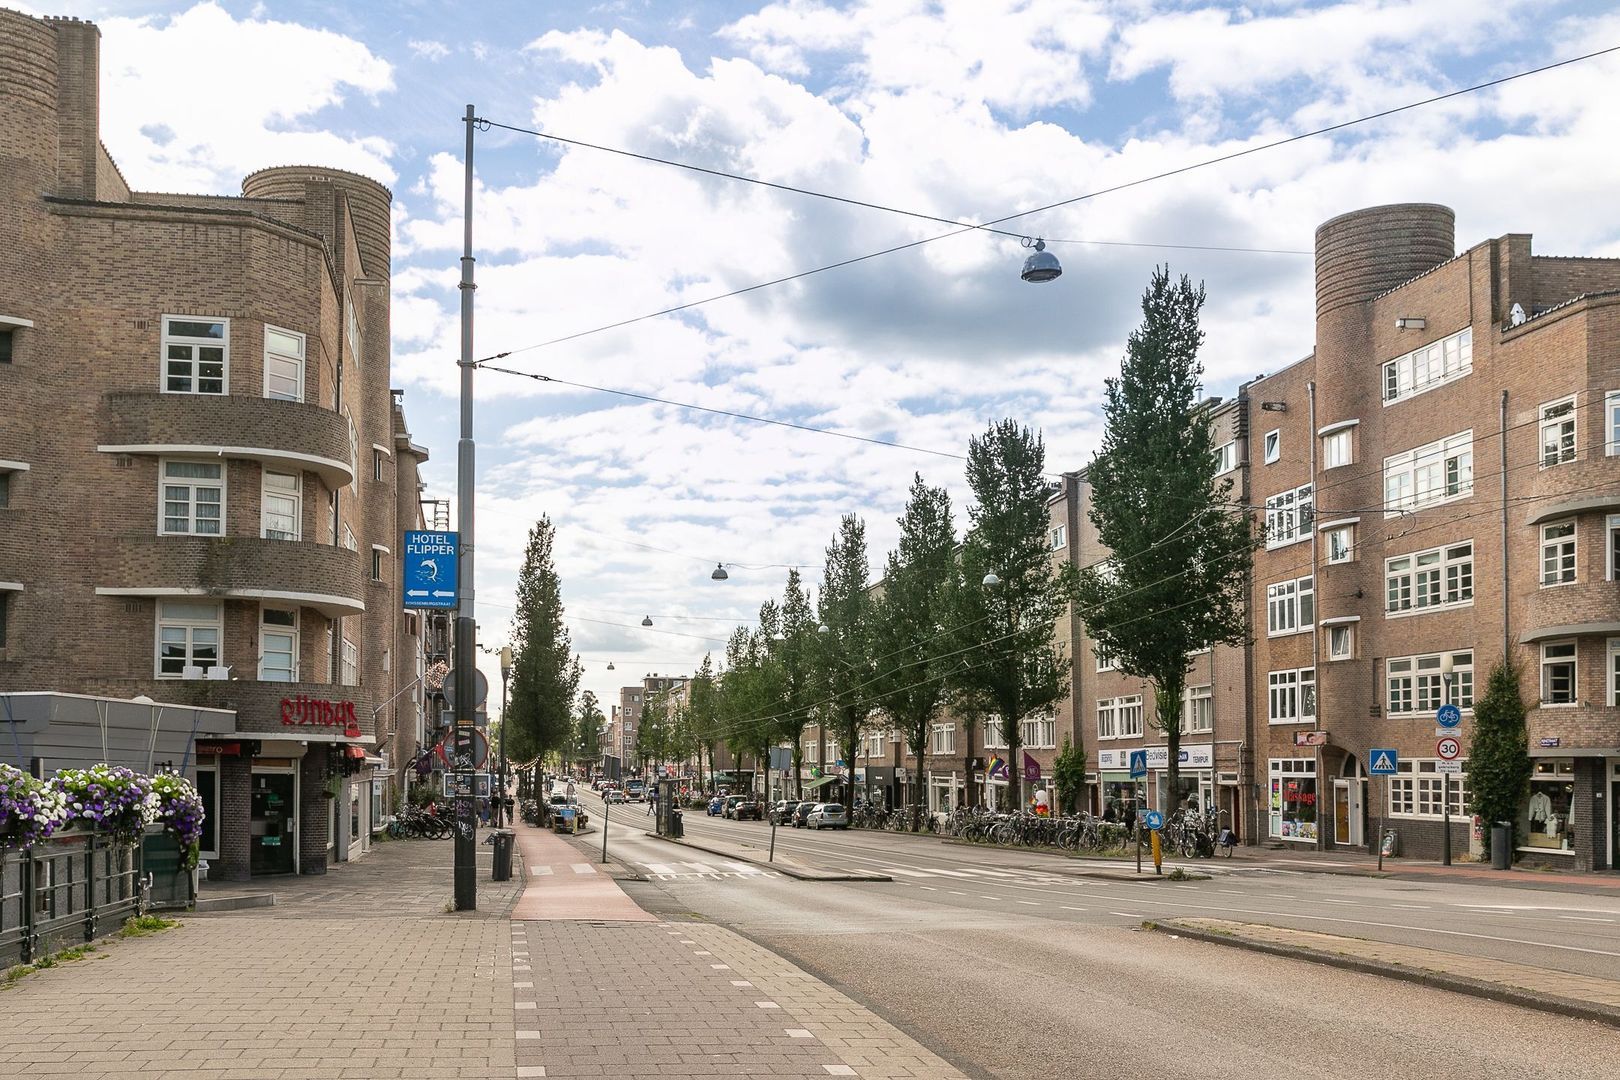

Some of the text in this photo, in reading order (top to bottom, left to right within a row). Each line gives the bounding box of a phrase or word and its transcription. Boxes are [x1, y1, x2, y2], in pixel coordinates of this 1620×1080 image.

[412, 534, 450, 545] HOTEL
[407, 544, 454, 555] FLIPPER
[1441, 744, 1457, 754] 30
[1192, 755, 1209, 764] TEMPUR
